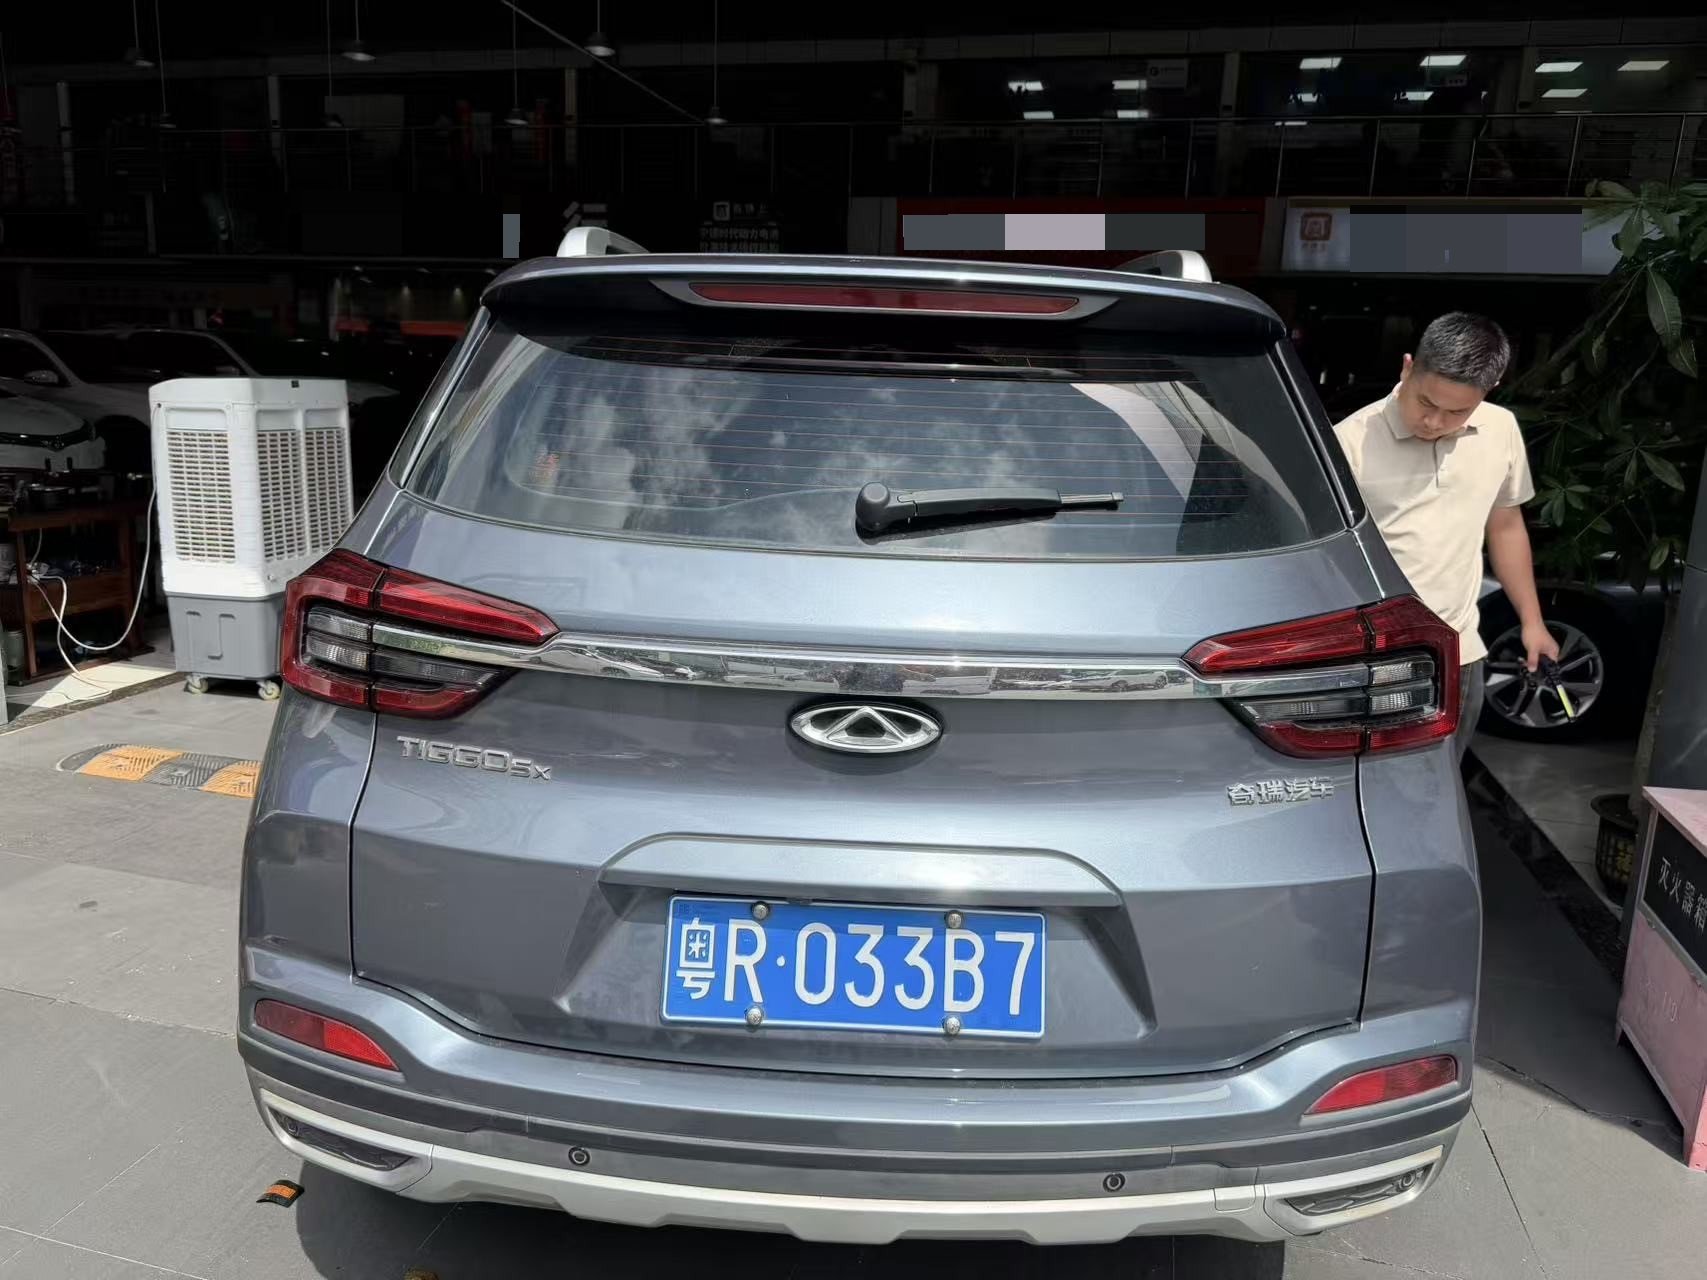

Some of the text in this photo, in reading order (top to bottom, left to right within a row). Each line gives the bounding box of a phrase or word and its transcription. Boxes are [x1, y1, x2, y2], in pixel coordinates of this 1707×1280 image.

[1227, 776, 1335, 806] 奇瑞汽车
[1658, 856, 1707, 933] 灭火器箱
